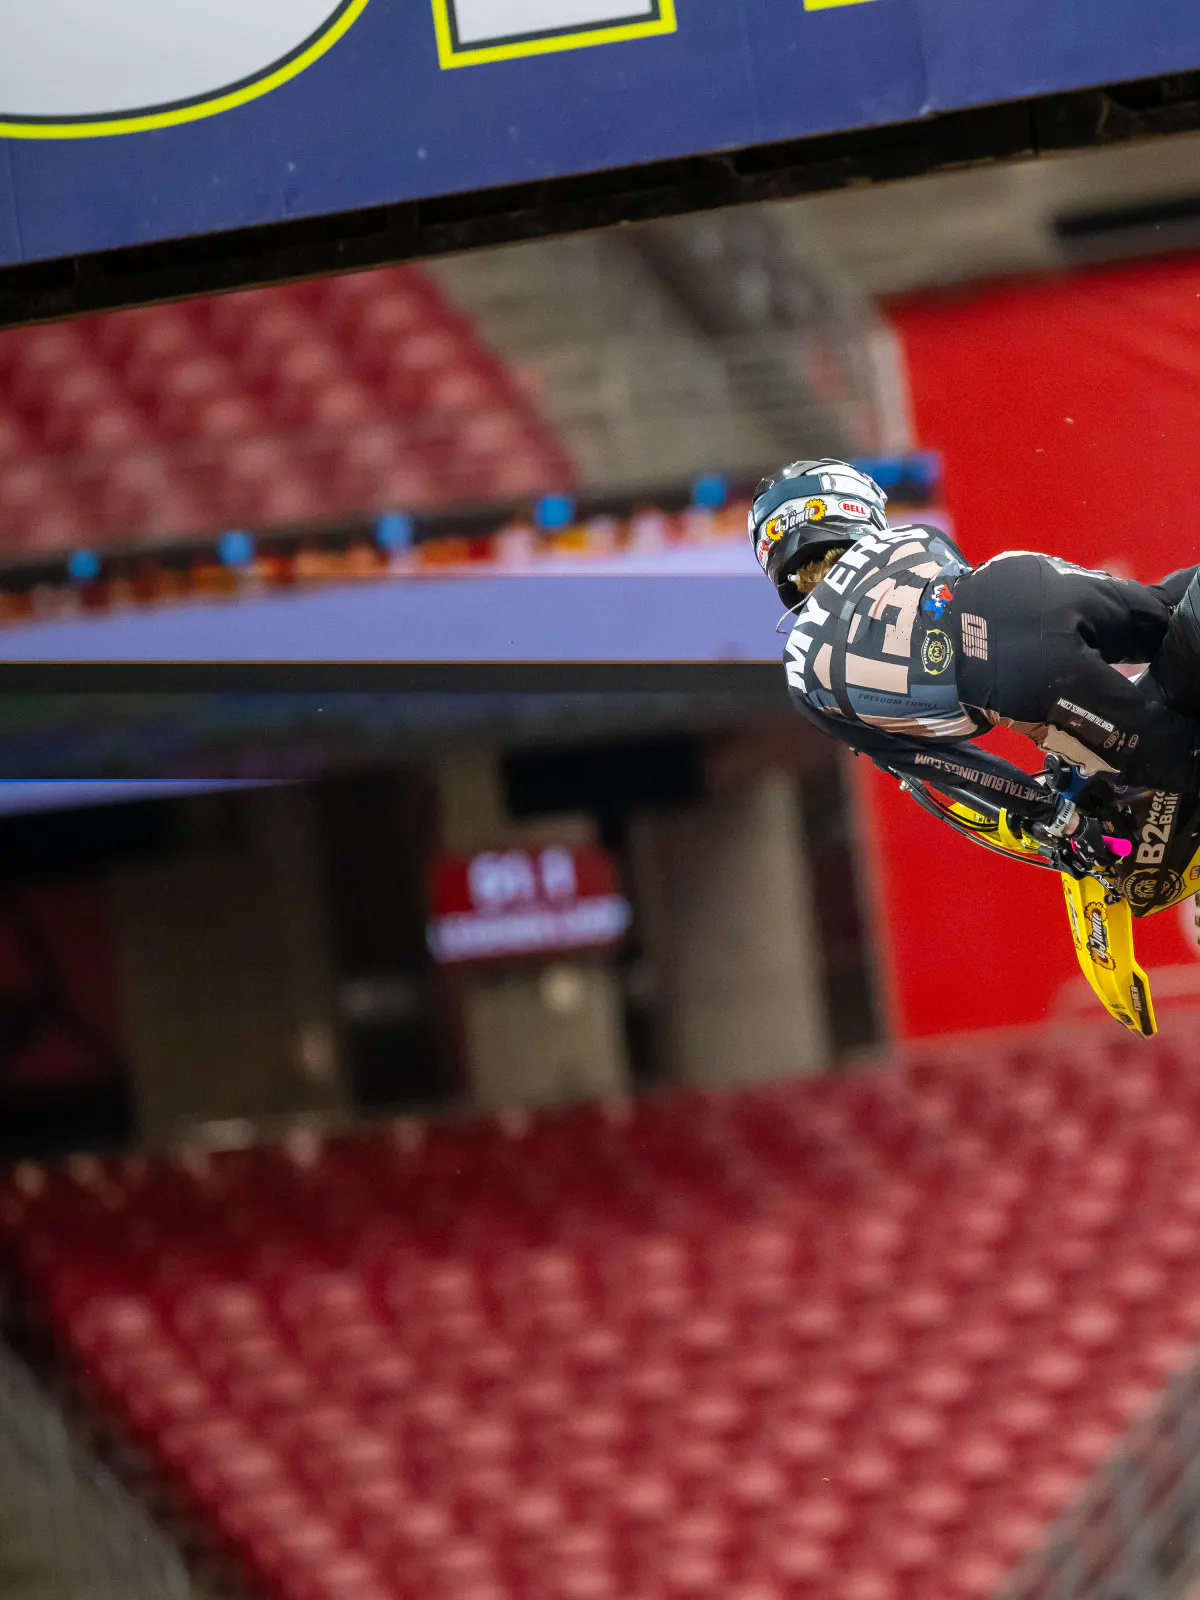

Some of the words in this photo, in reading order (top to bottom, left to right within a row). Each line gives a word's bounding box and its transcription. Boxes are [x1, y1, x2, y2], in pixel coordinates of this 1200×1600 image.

[782, 505, 816, 531] Jamie
[842, 502, 867, 515] BELL
[1135, 823, 1173, 866] B2
[1089, 912, 1106, 951] Jamie
[1130, 985, 1142, 1012] TAMER
